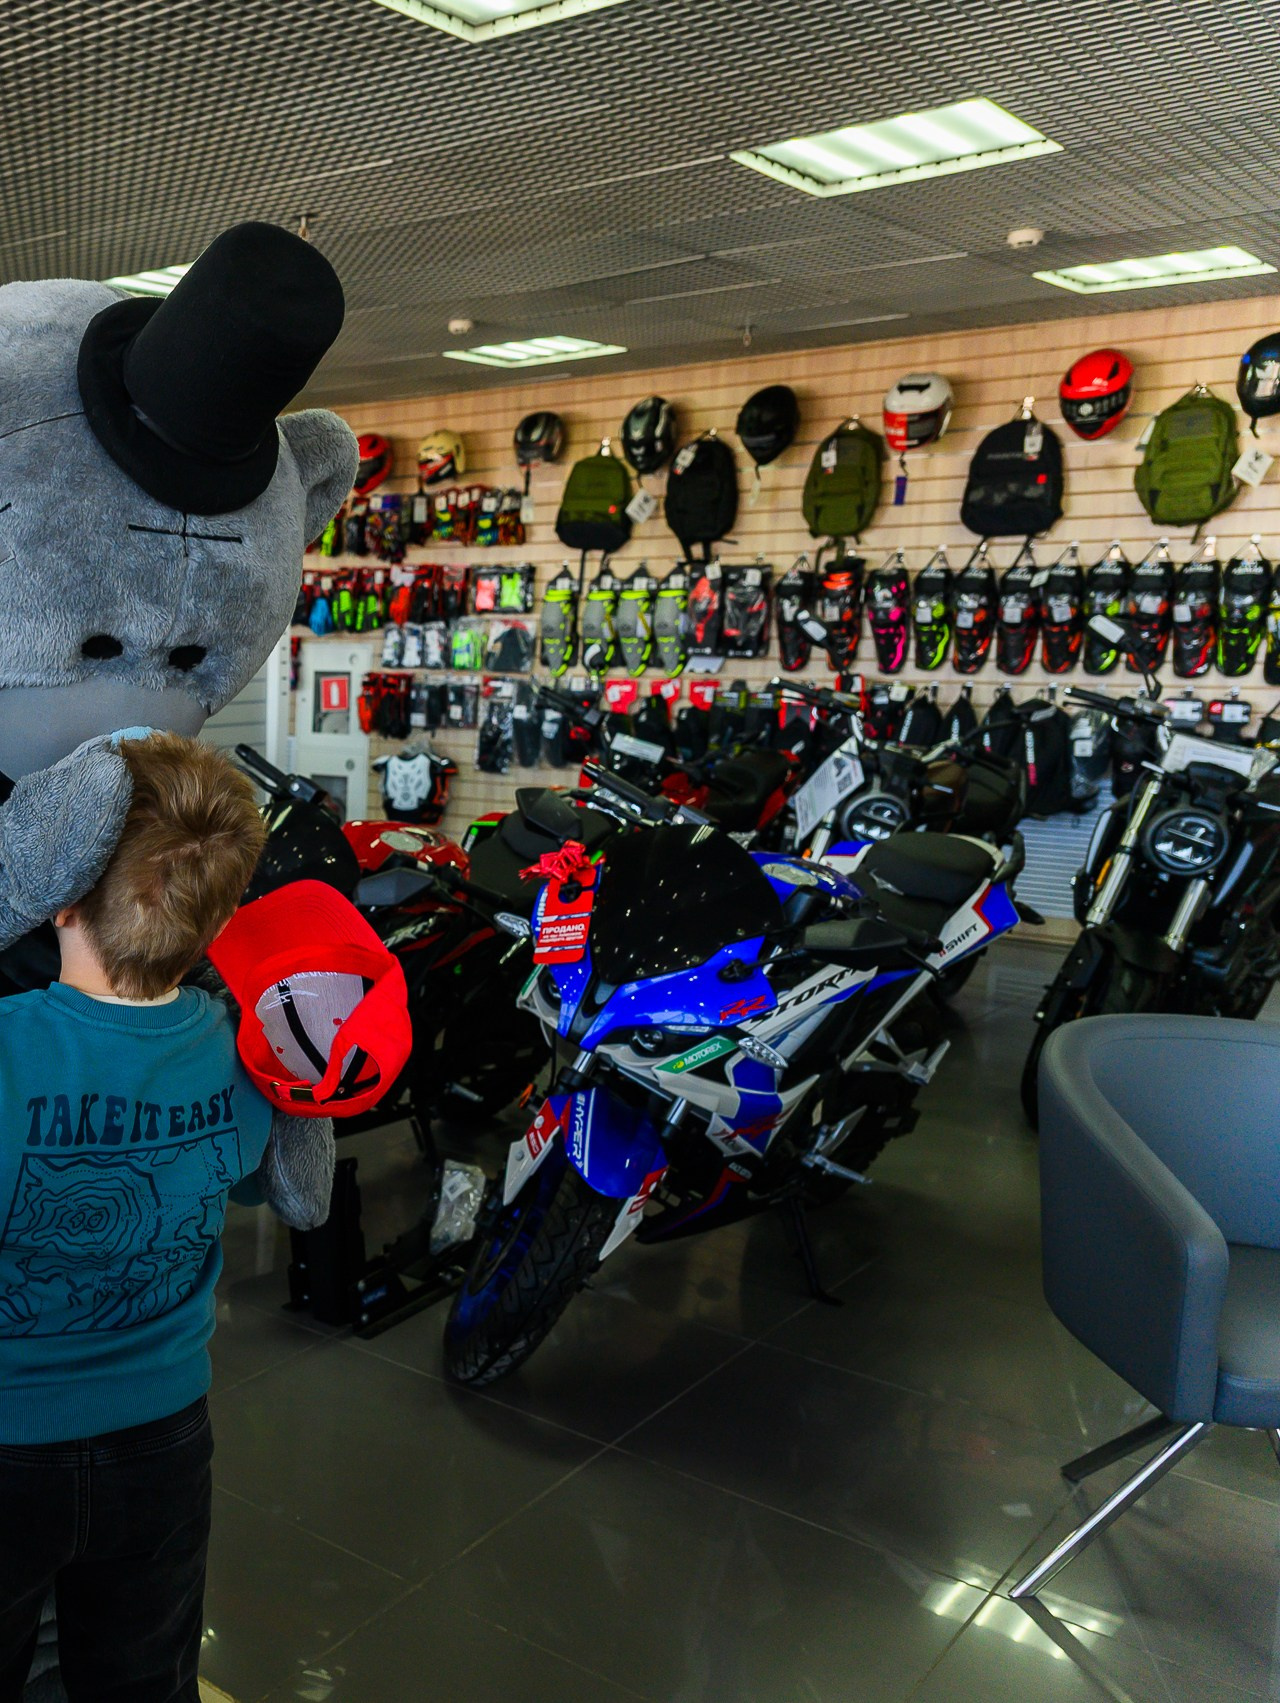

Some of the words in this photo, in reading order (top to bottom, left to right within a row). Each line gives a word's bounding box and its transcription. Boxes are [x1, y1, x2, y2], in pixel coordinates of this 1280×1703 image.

[684, 1042, 722, 1066] MOTOREX
[26, 1093, 127, 1147] TAKE
[130, 1101, 162, 1144] IT
[168, 1085, 235, 1138] EASY
